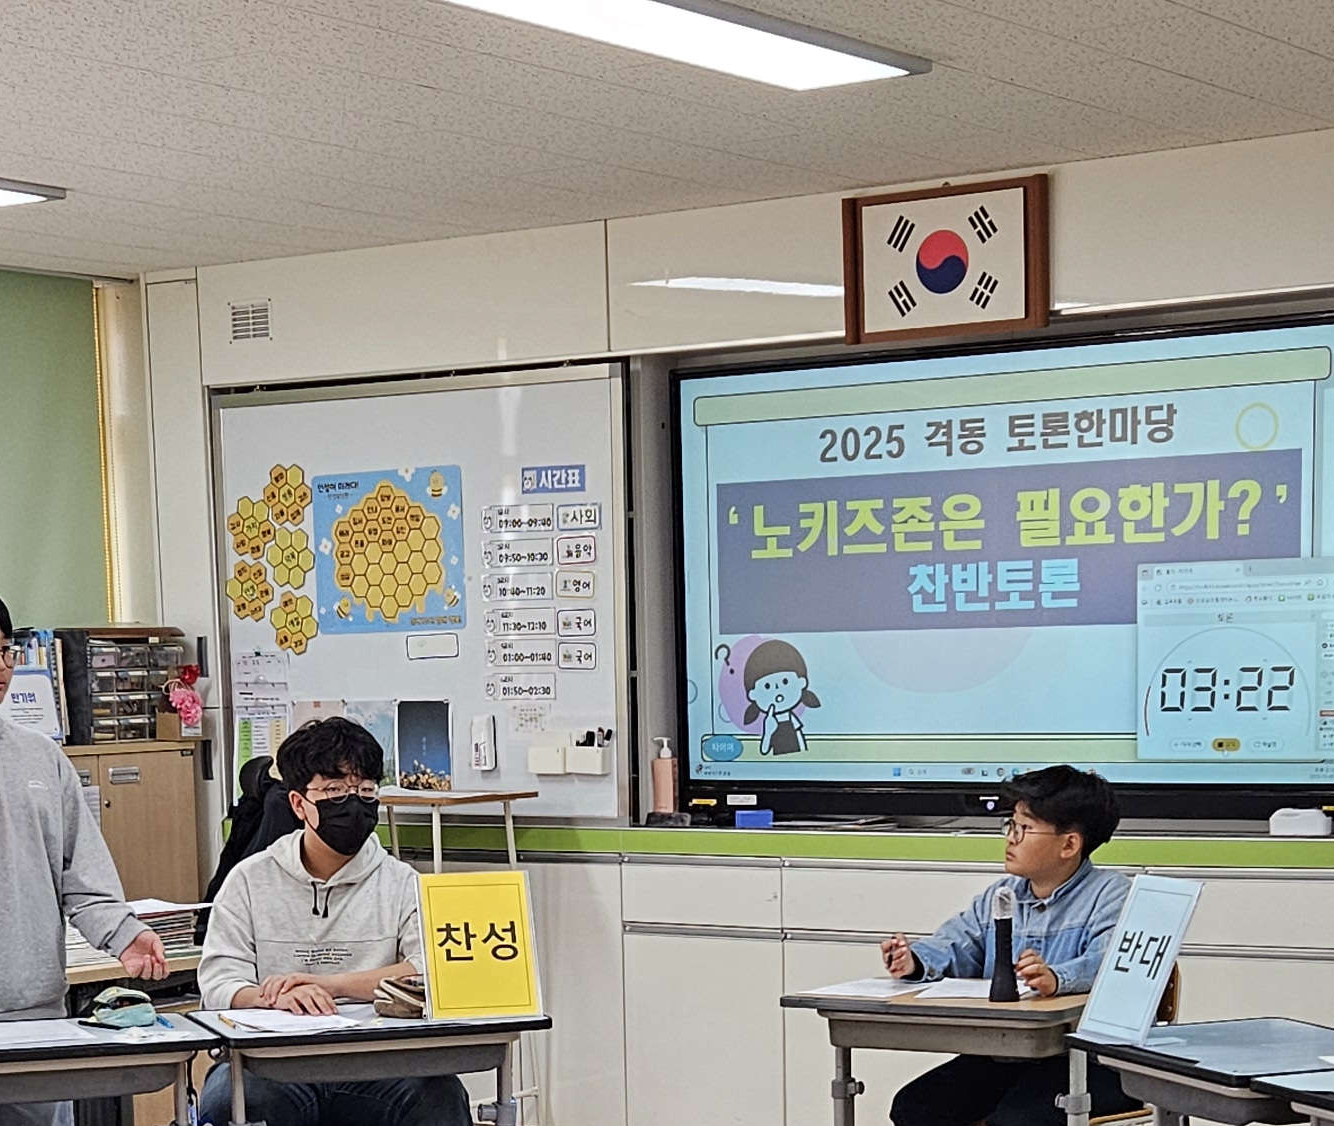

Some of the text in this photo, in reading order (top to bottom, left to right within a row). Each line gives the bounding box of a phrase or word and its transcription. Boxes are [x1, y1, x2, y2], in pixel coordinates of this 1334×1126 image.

[820, 403, 1178, 464] 2025 격동 토론한마당
[539, 469, 581, 489] 시간표
[575, 543, 592, 558] 음악
[573, 579, 591, 593] 영어
[907, 558, 1080, 614] 찬반토론
[576, 616, 592, 631] 국어
[576, 650, 592, 664] 국어
[1160, 665, 1295, 712] 03:22
[712, 742, 734, 752] 타이머
[437, 921, 519, 962] 찬성
[1114, 931, 1172, 980] 반대
